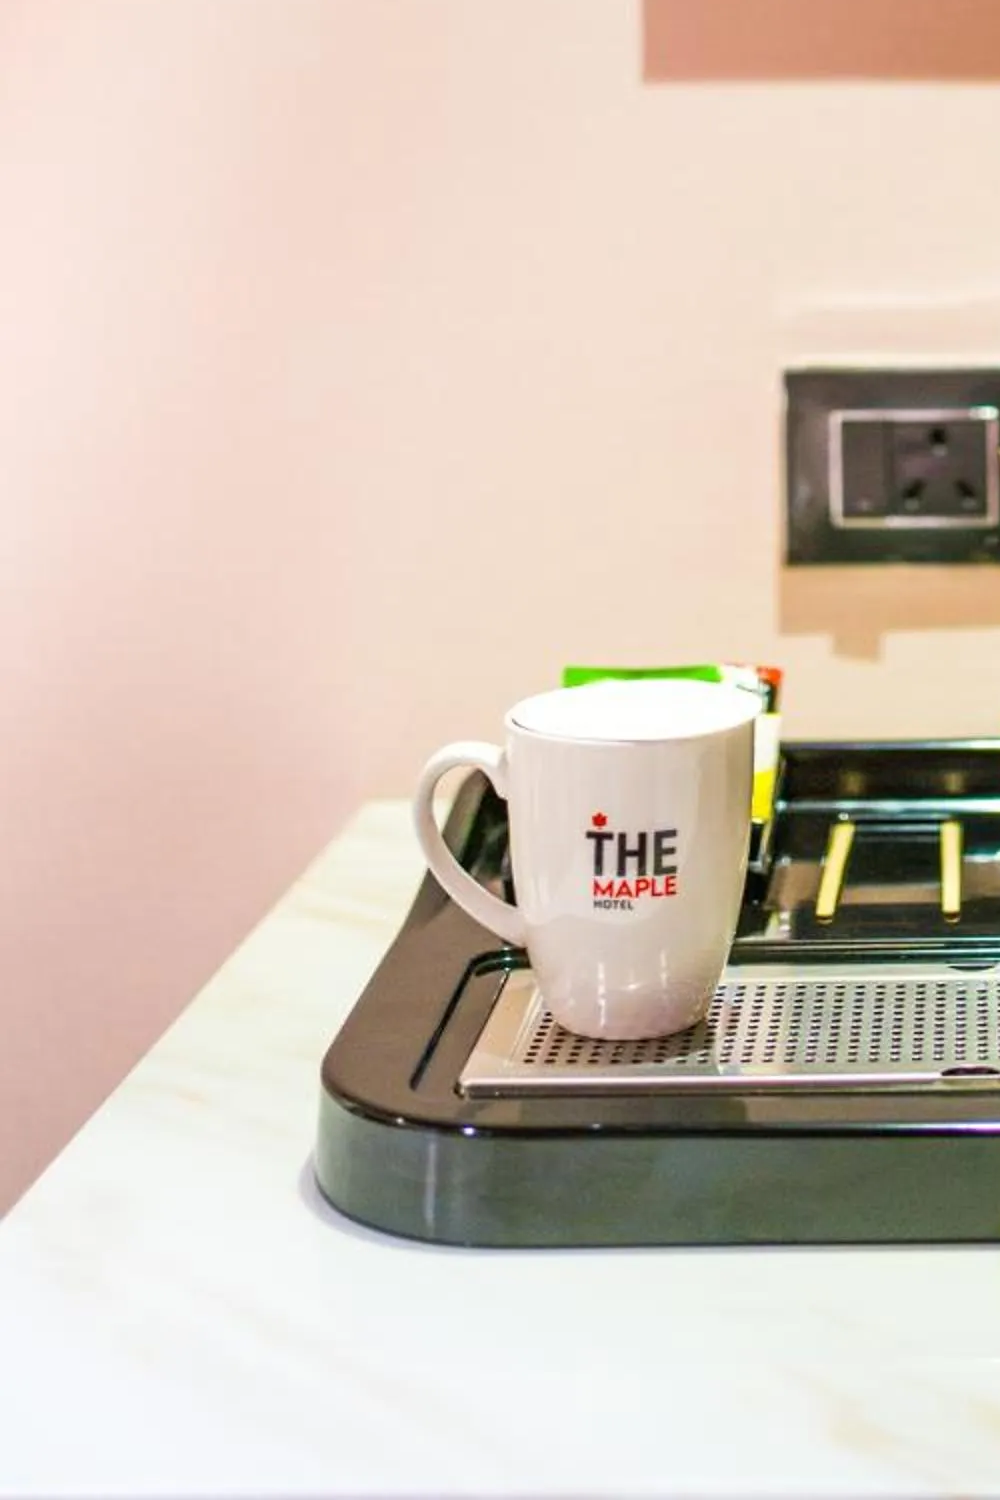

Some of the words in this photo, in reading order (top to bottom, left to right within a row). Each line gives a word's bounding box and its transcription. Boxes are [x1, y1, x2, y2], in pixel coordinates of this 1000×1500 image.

[585, 829, 677, 876] THE
[592, 876, 677, 898] MAPLE
[593, 900, 634, 911] HOTEL
